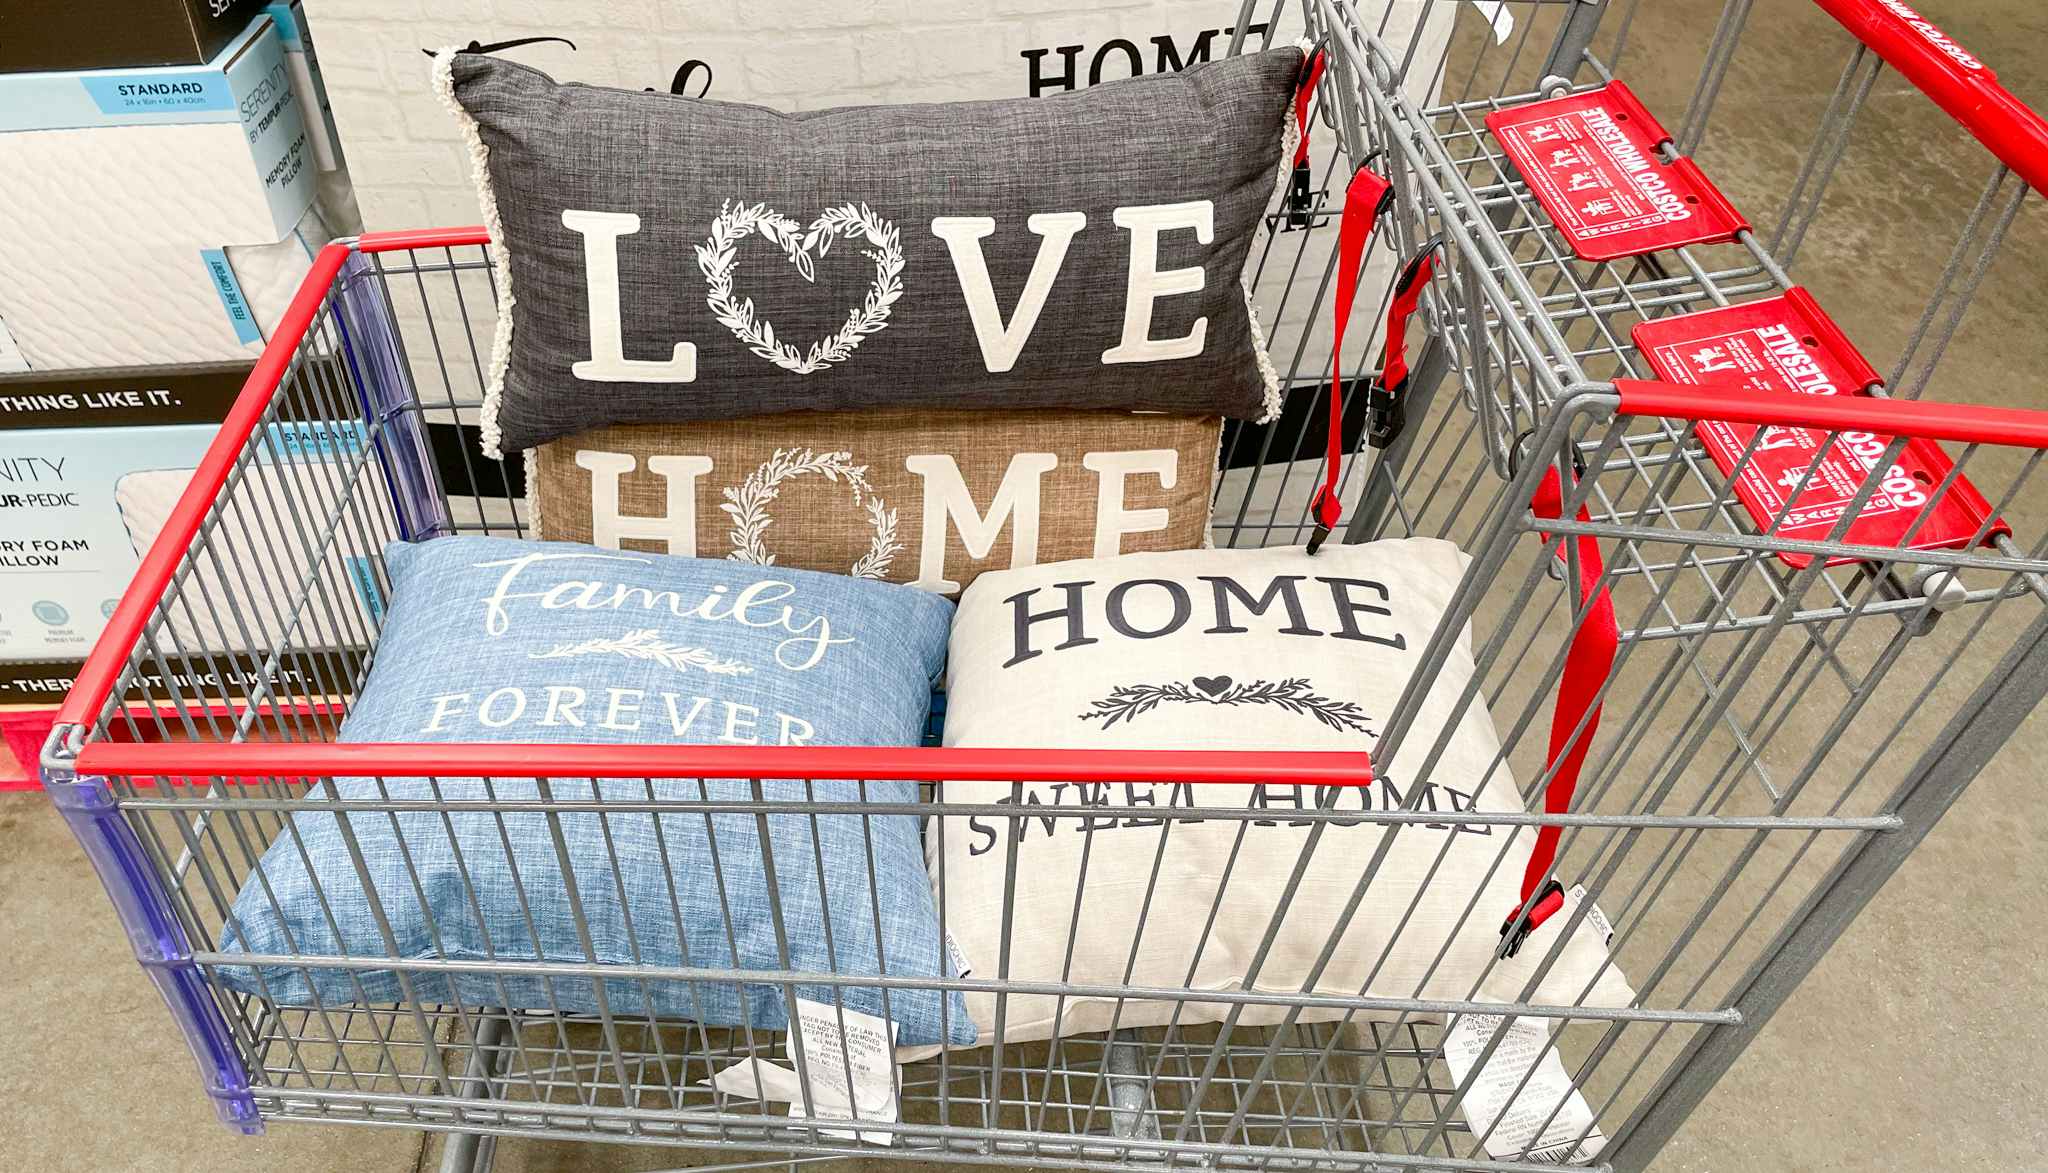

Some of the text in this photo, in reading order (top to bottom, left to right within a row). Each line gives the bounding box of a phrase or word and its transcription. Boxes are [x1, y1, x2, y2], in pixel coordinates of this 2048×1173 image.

[118, 82, 203, 96] STANDARD
[1582, 107, 1650, 174] WHOLESALE
[265, 134, 305, 188] MEMORY FOAM
[281, 158, 303, 189] PILLOW
[1634, 173, 1692, 221] COSTCO
[1588, 215, 1663, 237] WARNING
[82, 391, 144, 409] LIKE
[146, 389, 182, 406] IT.
[1790, 498, 1890, 525] WARNNG
[0, 540, 89, 552] RY FOAM
[1003, 575, 1406, 668] HOME
[418, 685, 816, 746] FOREVER
[1254, 777, 1492, 836] HOME
